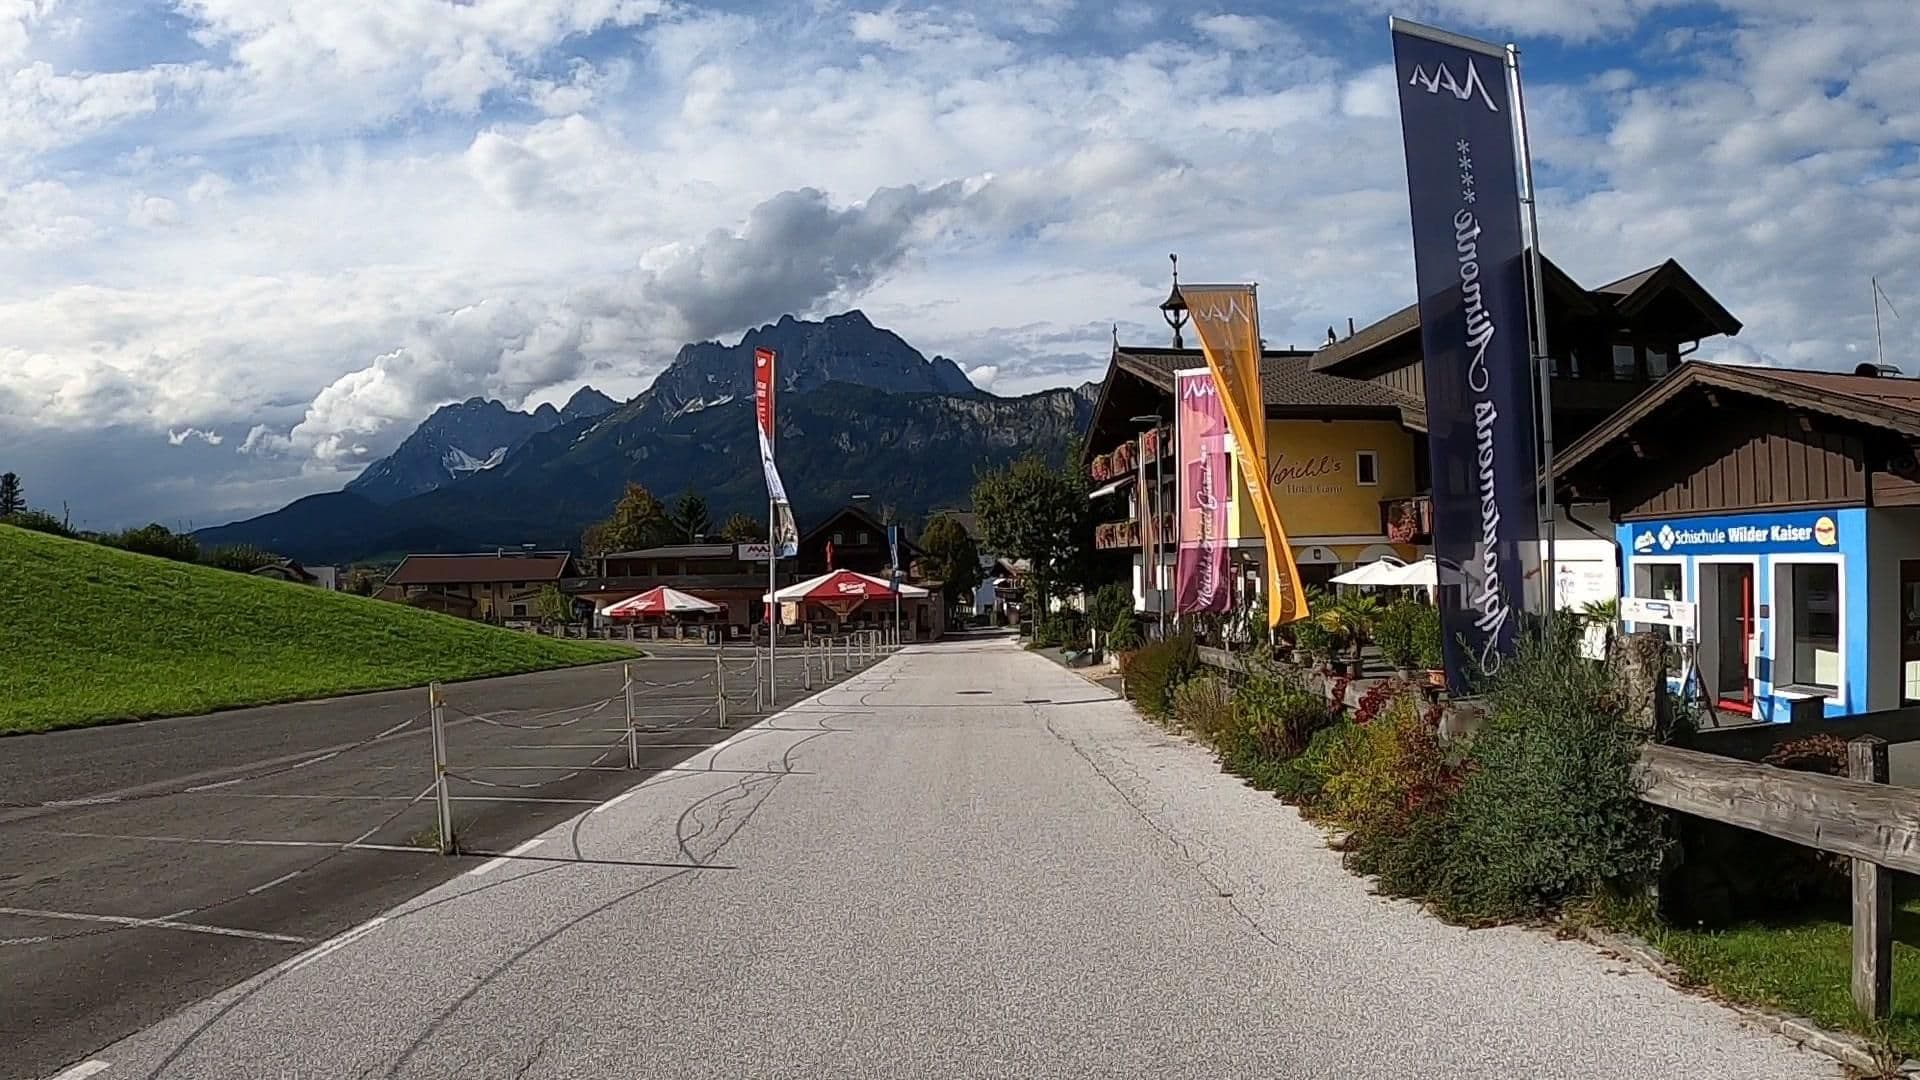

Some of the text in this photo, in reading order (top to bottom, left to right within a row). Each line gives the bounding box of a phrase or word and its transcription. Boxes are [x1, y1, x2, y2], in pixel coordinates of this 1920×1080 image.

[1674, 524, 1813, 546] Schischule Wilder Kaiser
